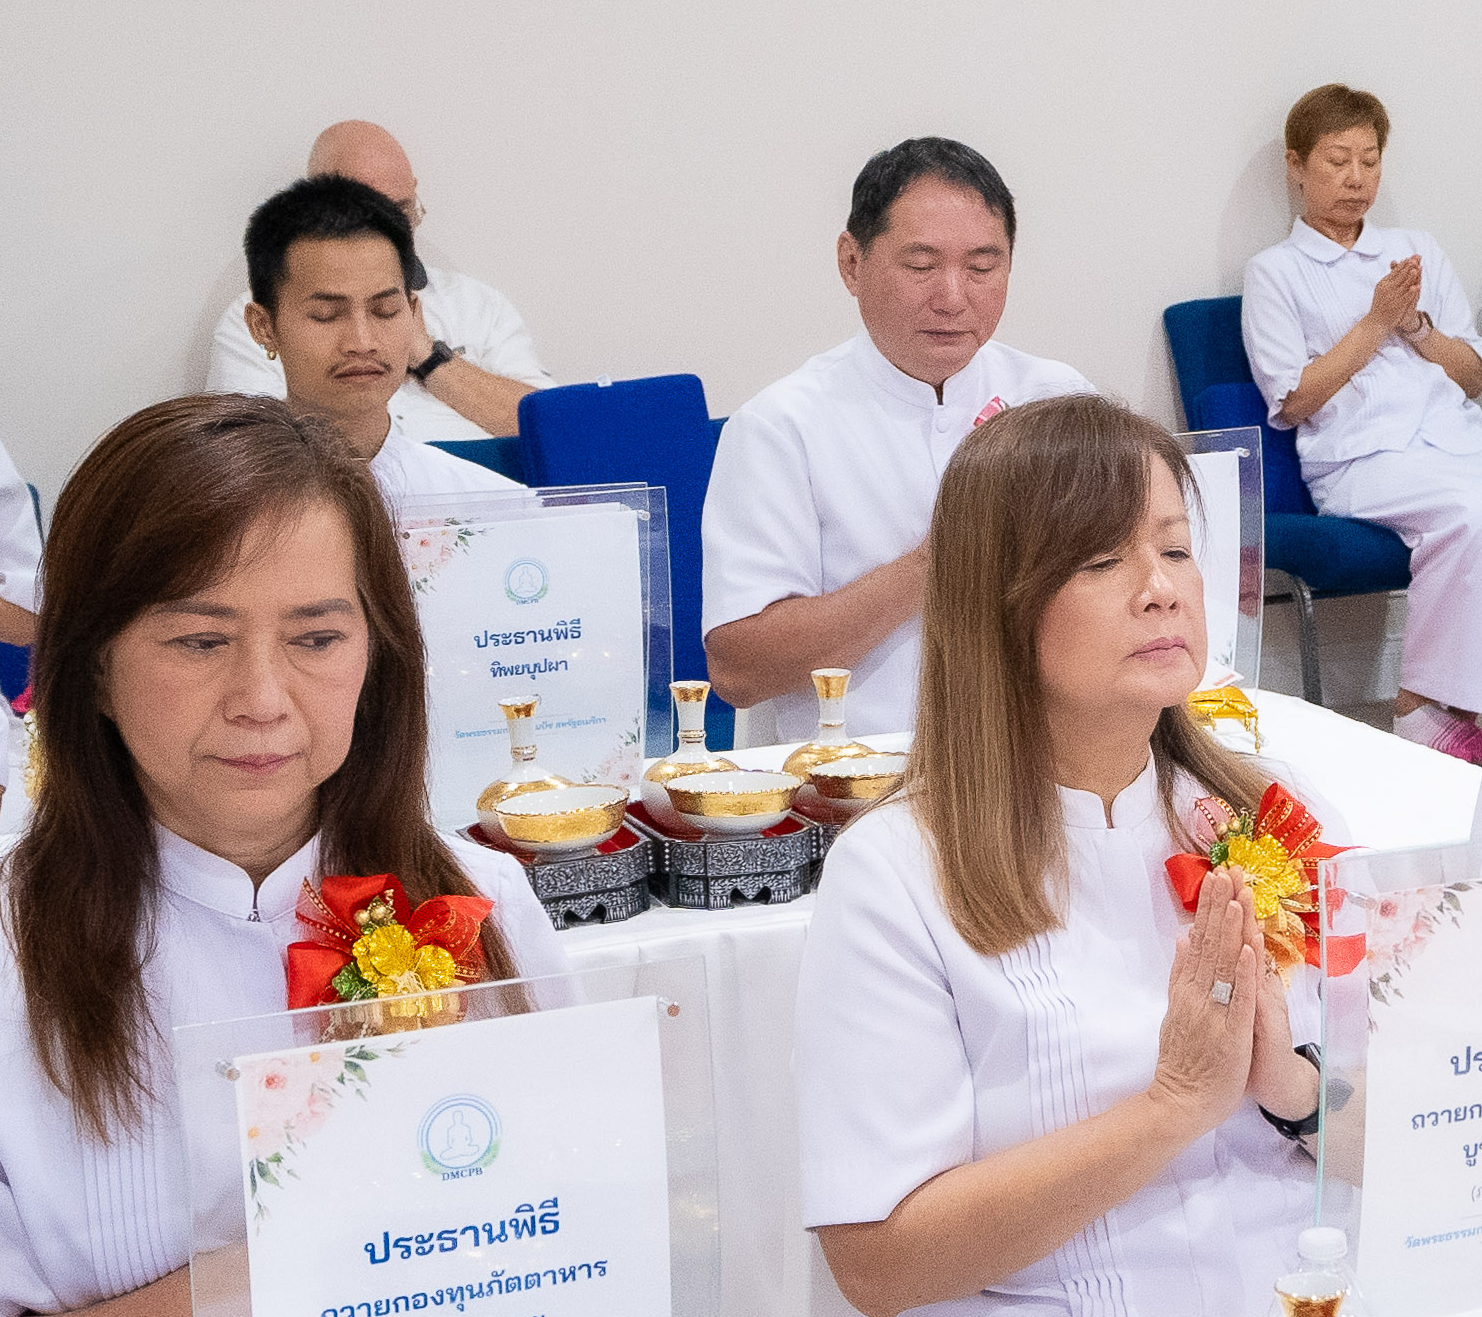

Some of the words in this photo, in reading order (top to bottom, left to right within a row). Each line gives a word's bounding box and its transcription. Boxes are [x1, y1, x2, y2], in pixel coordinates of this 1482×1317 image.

[473, 618, 582, 649] ประธานพิธี
[489, 658, 569, 680] ทิพยบุปผา
[441, 1167, 484, 1182] DMCPB
[363, 1196, 562, 1266] ประธานพิธี
